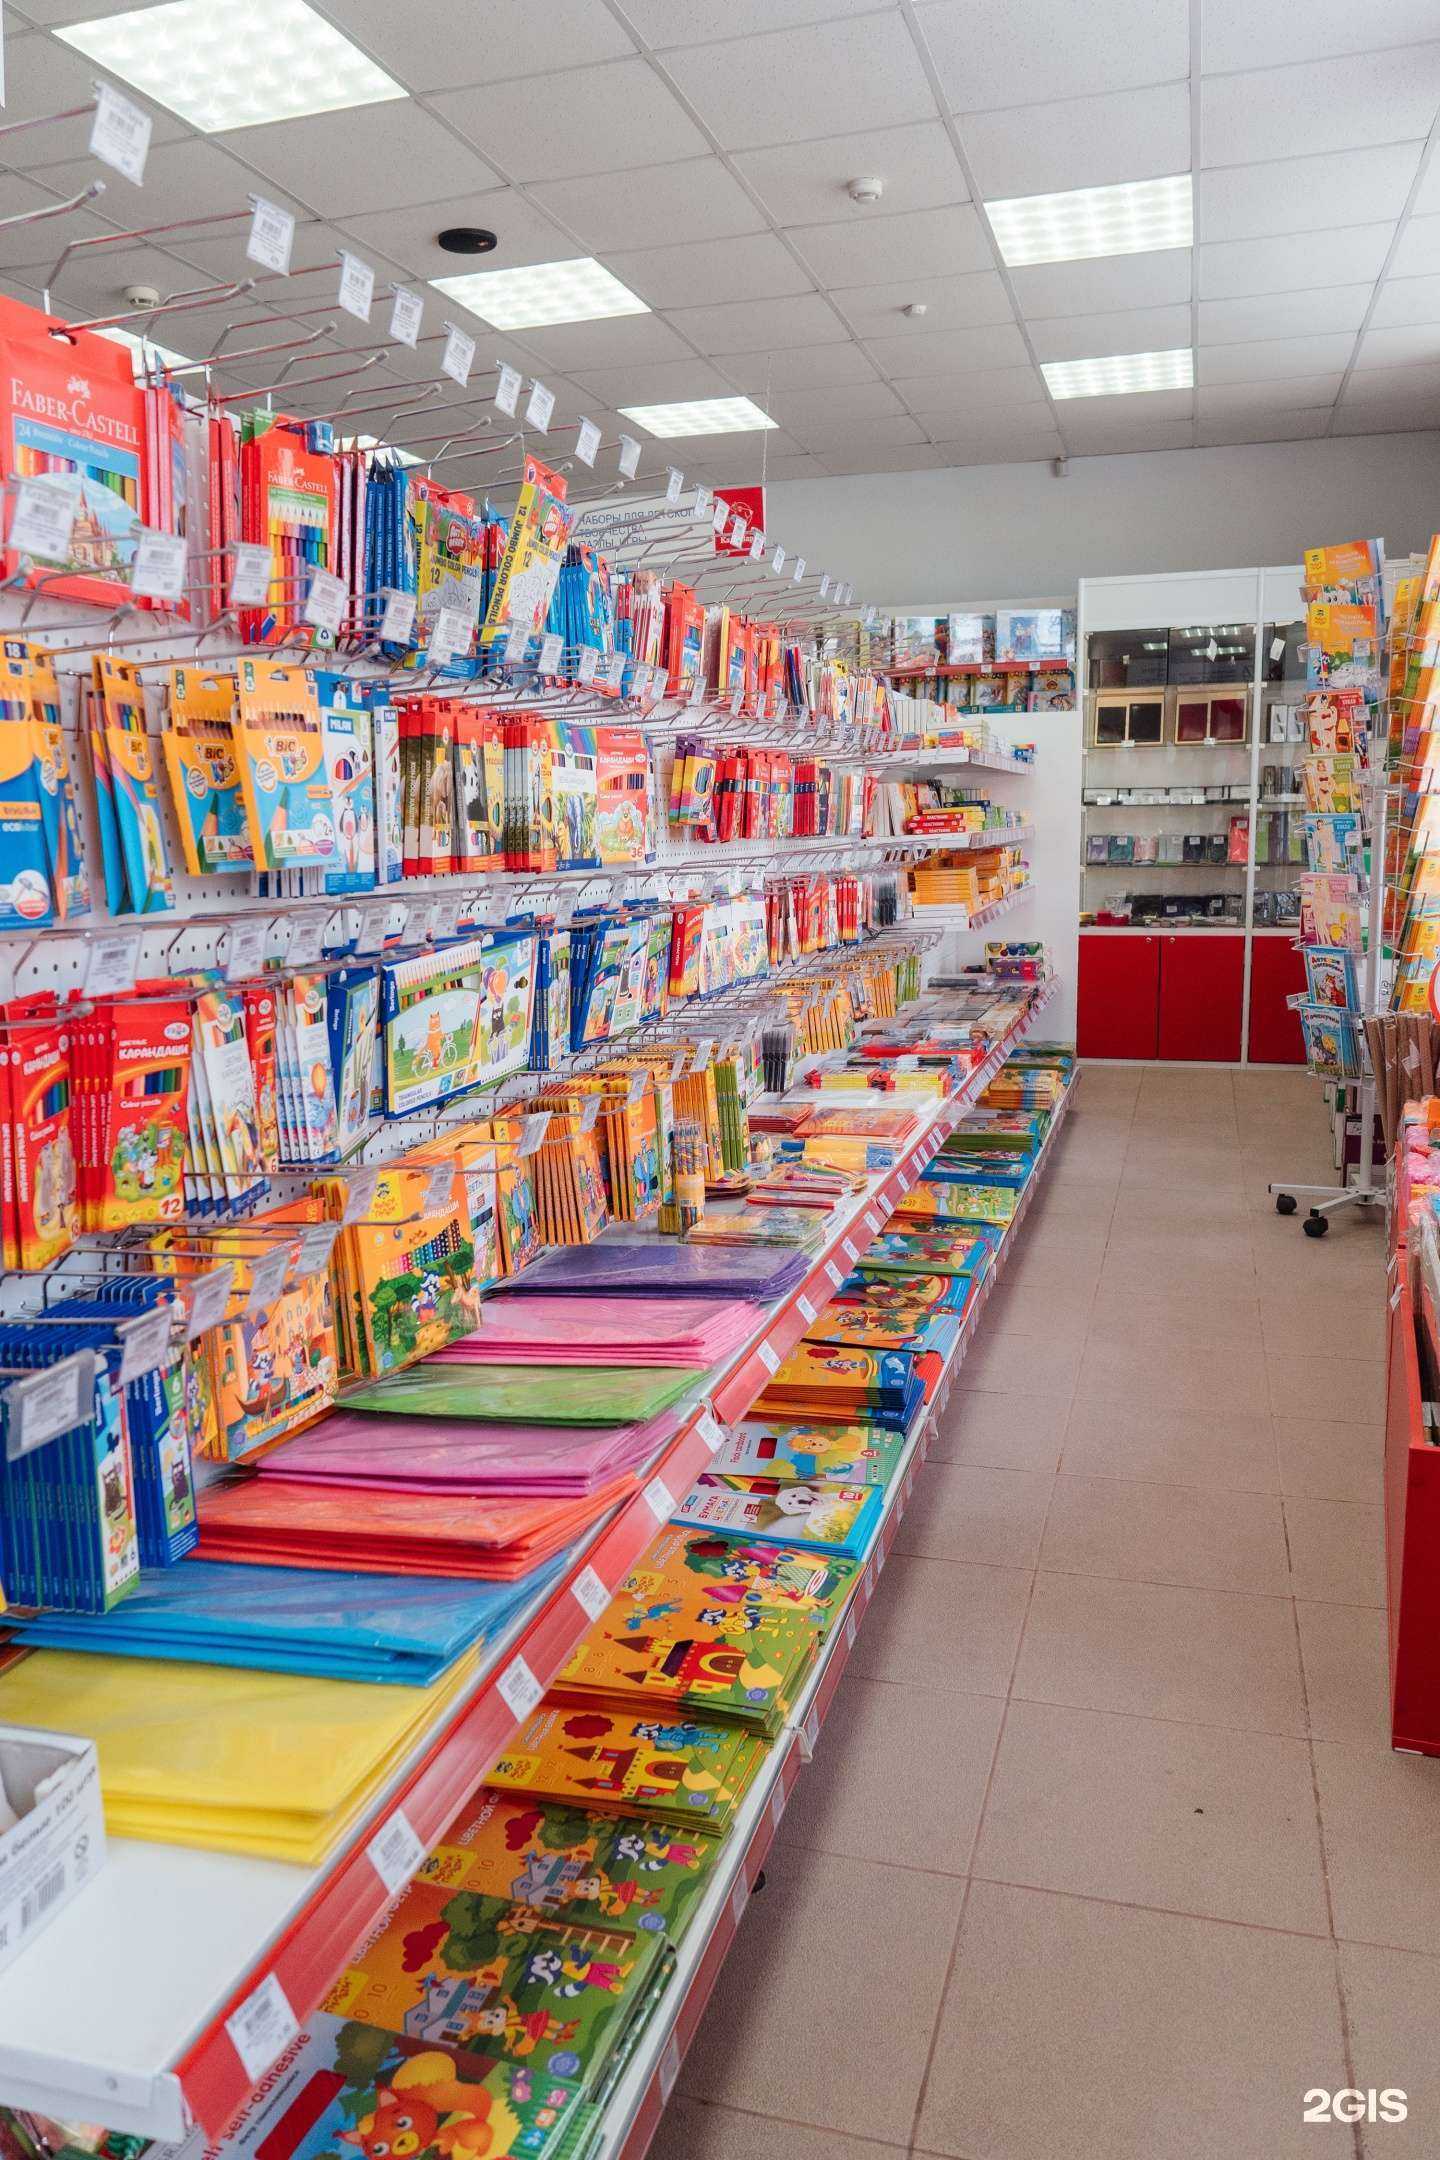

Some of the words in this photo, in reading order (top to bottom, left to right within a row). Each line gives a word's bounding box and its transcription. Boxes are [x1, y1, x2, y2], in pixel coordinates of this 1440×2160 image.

[11, 378, 140, 445] FABER-CASTELL
[268, 471, 328, 493] FABER-CASTELL
[518, 505, 527, 517] 12
[511, 519, 523, 553] JUMBO
[431, 567, 440, 584] 12
[501, 553, 514, 585] COLOR
[489, 587, 504, 626] PENCILS
[6, 643, 20, 657] 18
[306, 670, 314, 681] 12
[631, 847, 643, 858] 36
[24, 1050, 61, 1076] КАРАНДАШИ
[119, 1044, 188, 1060] КАРАНДАШИ
[2, 1123, 10, 1157] ЦВЕТНЫЕ
[16, 1123, 26, 1158] ЦВЕТНЫЕ
[4, 1159, 12, 1202] КАРАНДАШИ
[19, 1159, 28, 1202] КАРАНДАШИ
[162, 1200, 181, 1215] 12
[153, 1370, 162, 1416] Berlingo
[172, 1376, 180, 1393] 6
[699, 1496, 719, 1519] БУМАГА
[458, 1805, 495, 1846] ЦВЕТНОЙ
[368, 1982, 388, 1998] 10
